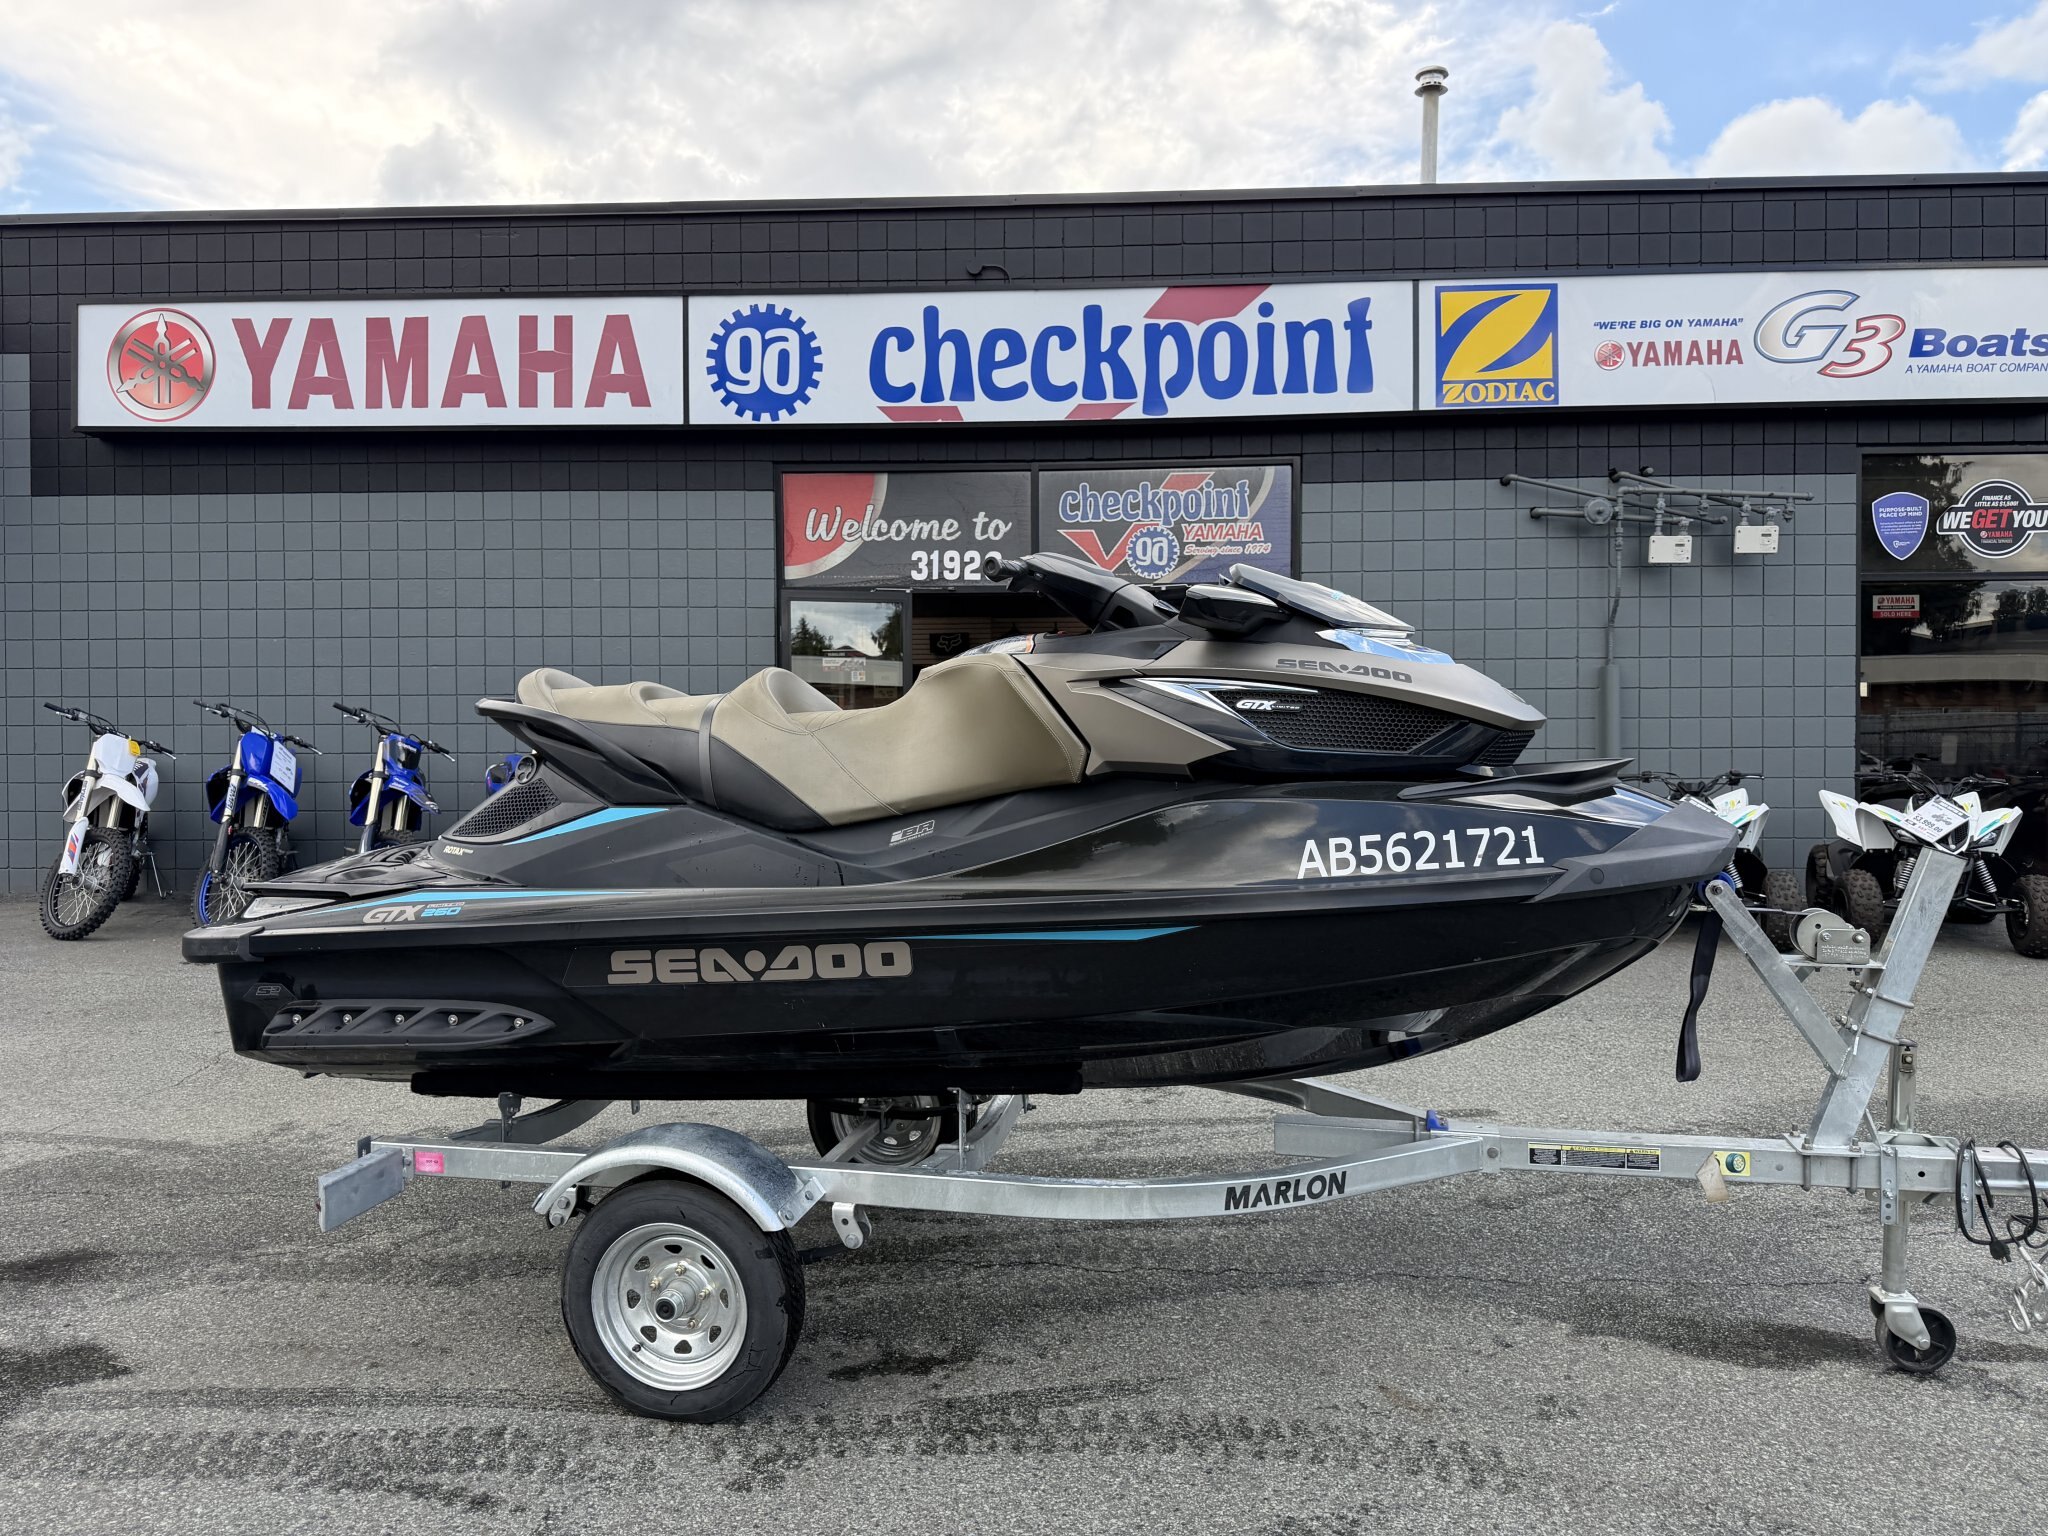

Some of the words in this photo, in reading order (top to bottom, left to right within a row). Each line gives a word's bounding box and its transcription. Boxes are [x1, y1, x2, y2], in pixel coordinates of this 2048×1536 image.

[1640, 320, 1661, 329] BIG
[1665, 319, 1683, 328] ON
[1627, 339, 1744, 367] YAMAHA
[1909, 328, 2048, 358] Boats
[231, 314, 652, 409] YAMAHA
[869, 297, 1374, 416] checkpoint
[1905, 365, 1913, 374] A
[1917, 364, 1963, 373] YAMAHA
[1966, 363, 1998, 373] BOAT
[1442, 382, 1556, 405] ZODIAC
[1059, 480, 1249, 527] checkpoint
[805, 504, 961, 542] Welcome
[972, 511, 1012, 541] to
[1182, 522, 1264, 542] YAMAHA
[1184, 545, 1218, 556] Serving
[1220, 546, 1241, 554] since
[1244, 543, 1271, 554] 1974
[911, 550, 1002, 581] 3192
[1885, 596, 1915, 605] YAMAHA
[1236, 700, 1277, 710] GTX
[443, 846, 464, 855] ROTAX
[1297, 825, 1545, 880] AB5621721
[363, 904, 425, 923] GTX
[421, 907, 461, 917] 260
[1224, 1171, 1347, 1211] MARLON
